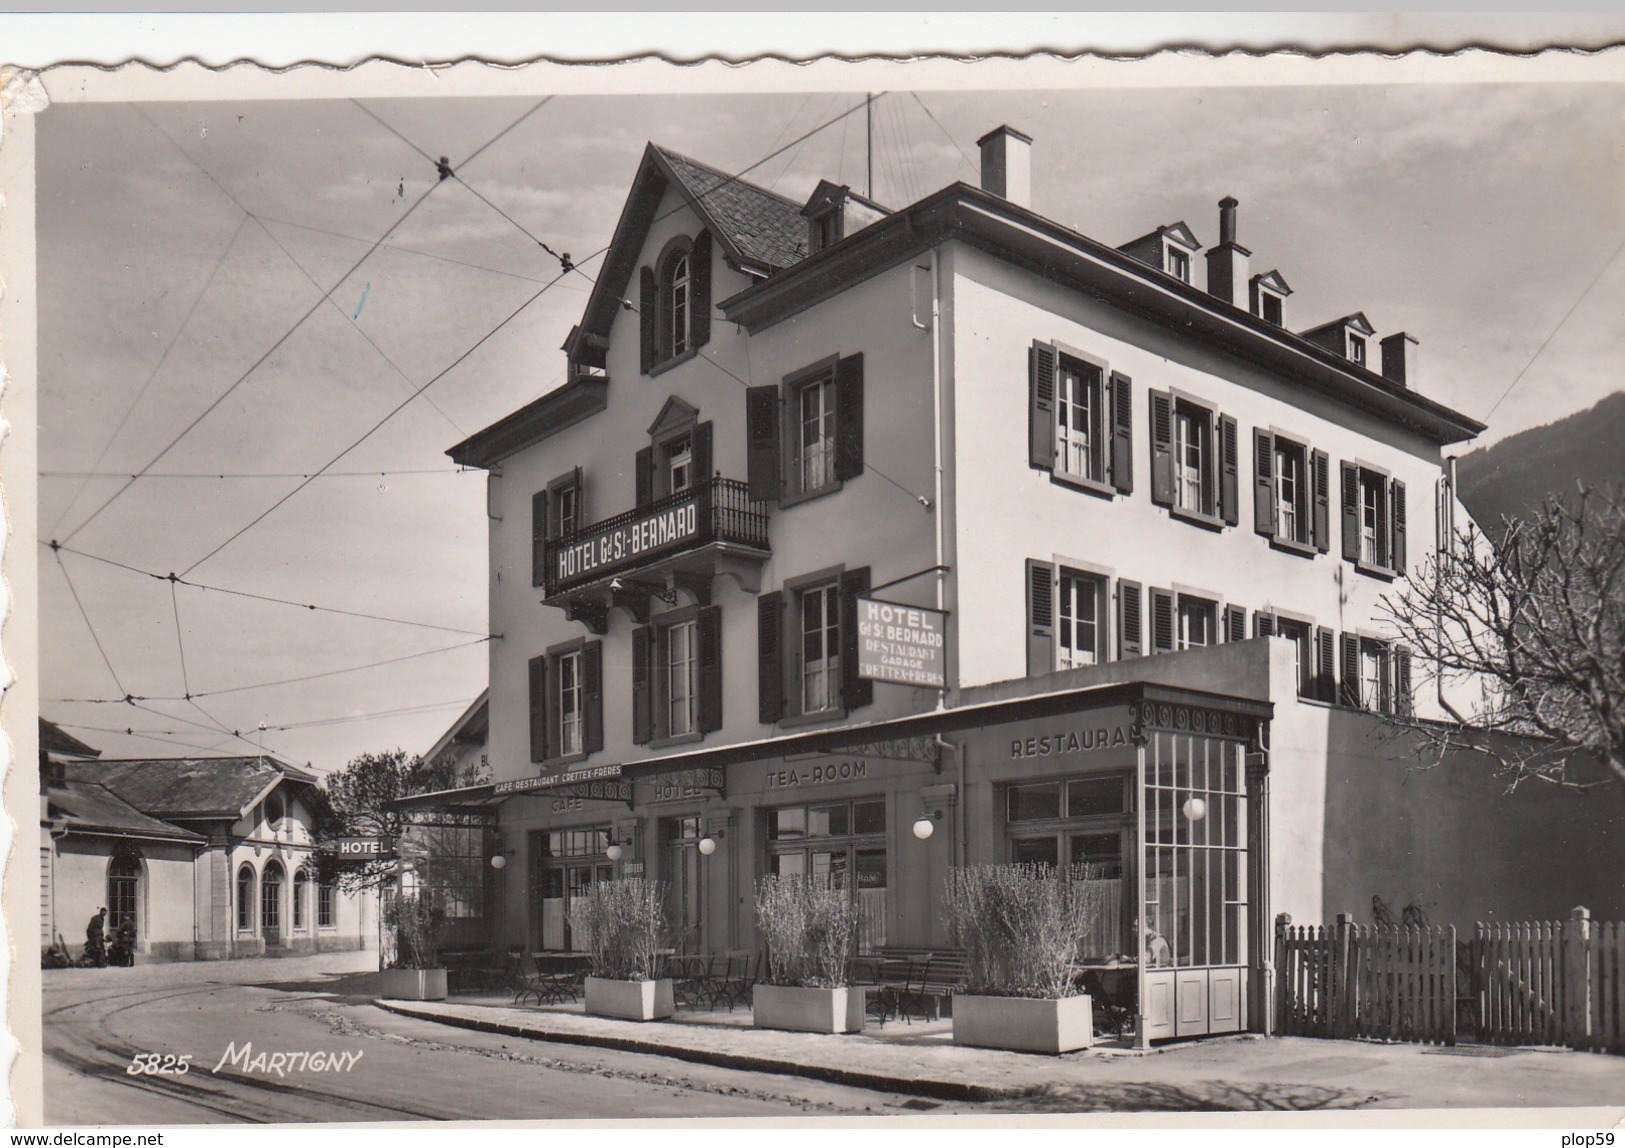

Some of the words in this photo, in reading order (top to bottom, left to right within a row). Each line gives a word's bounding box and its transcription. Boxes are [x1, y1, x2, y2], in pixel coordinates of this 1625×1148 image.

[559, 540, 598, 579] HÔTEL
[867, 604, 932, 629] HOTEL
[887, 625, 943, 647] BERNARD
[867, 640, 935, 660] RESTAURANT
[881, 656, 922, 669] GARAGE
[766, 760, 867, 788] TEA-ROOM
[655, 785, 703, 801] HOTEL
[341, 841, 389, 855] HOTEL
